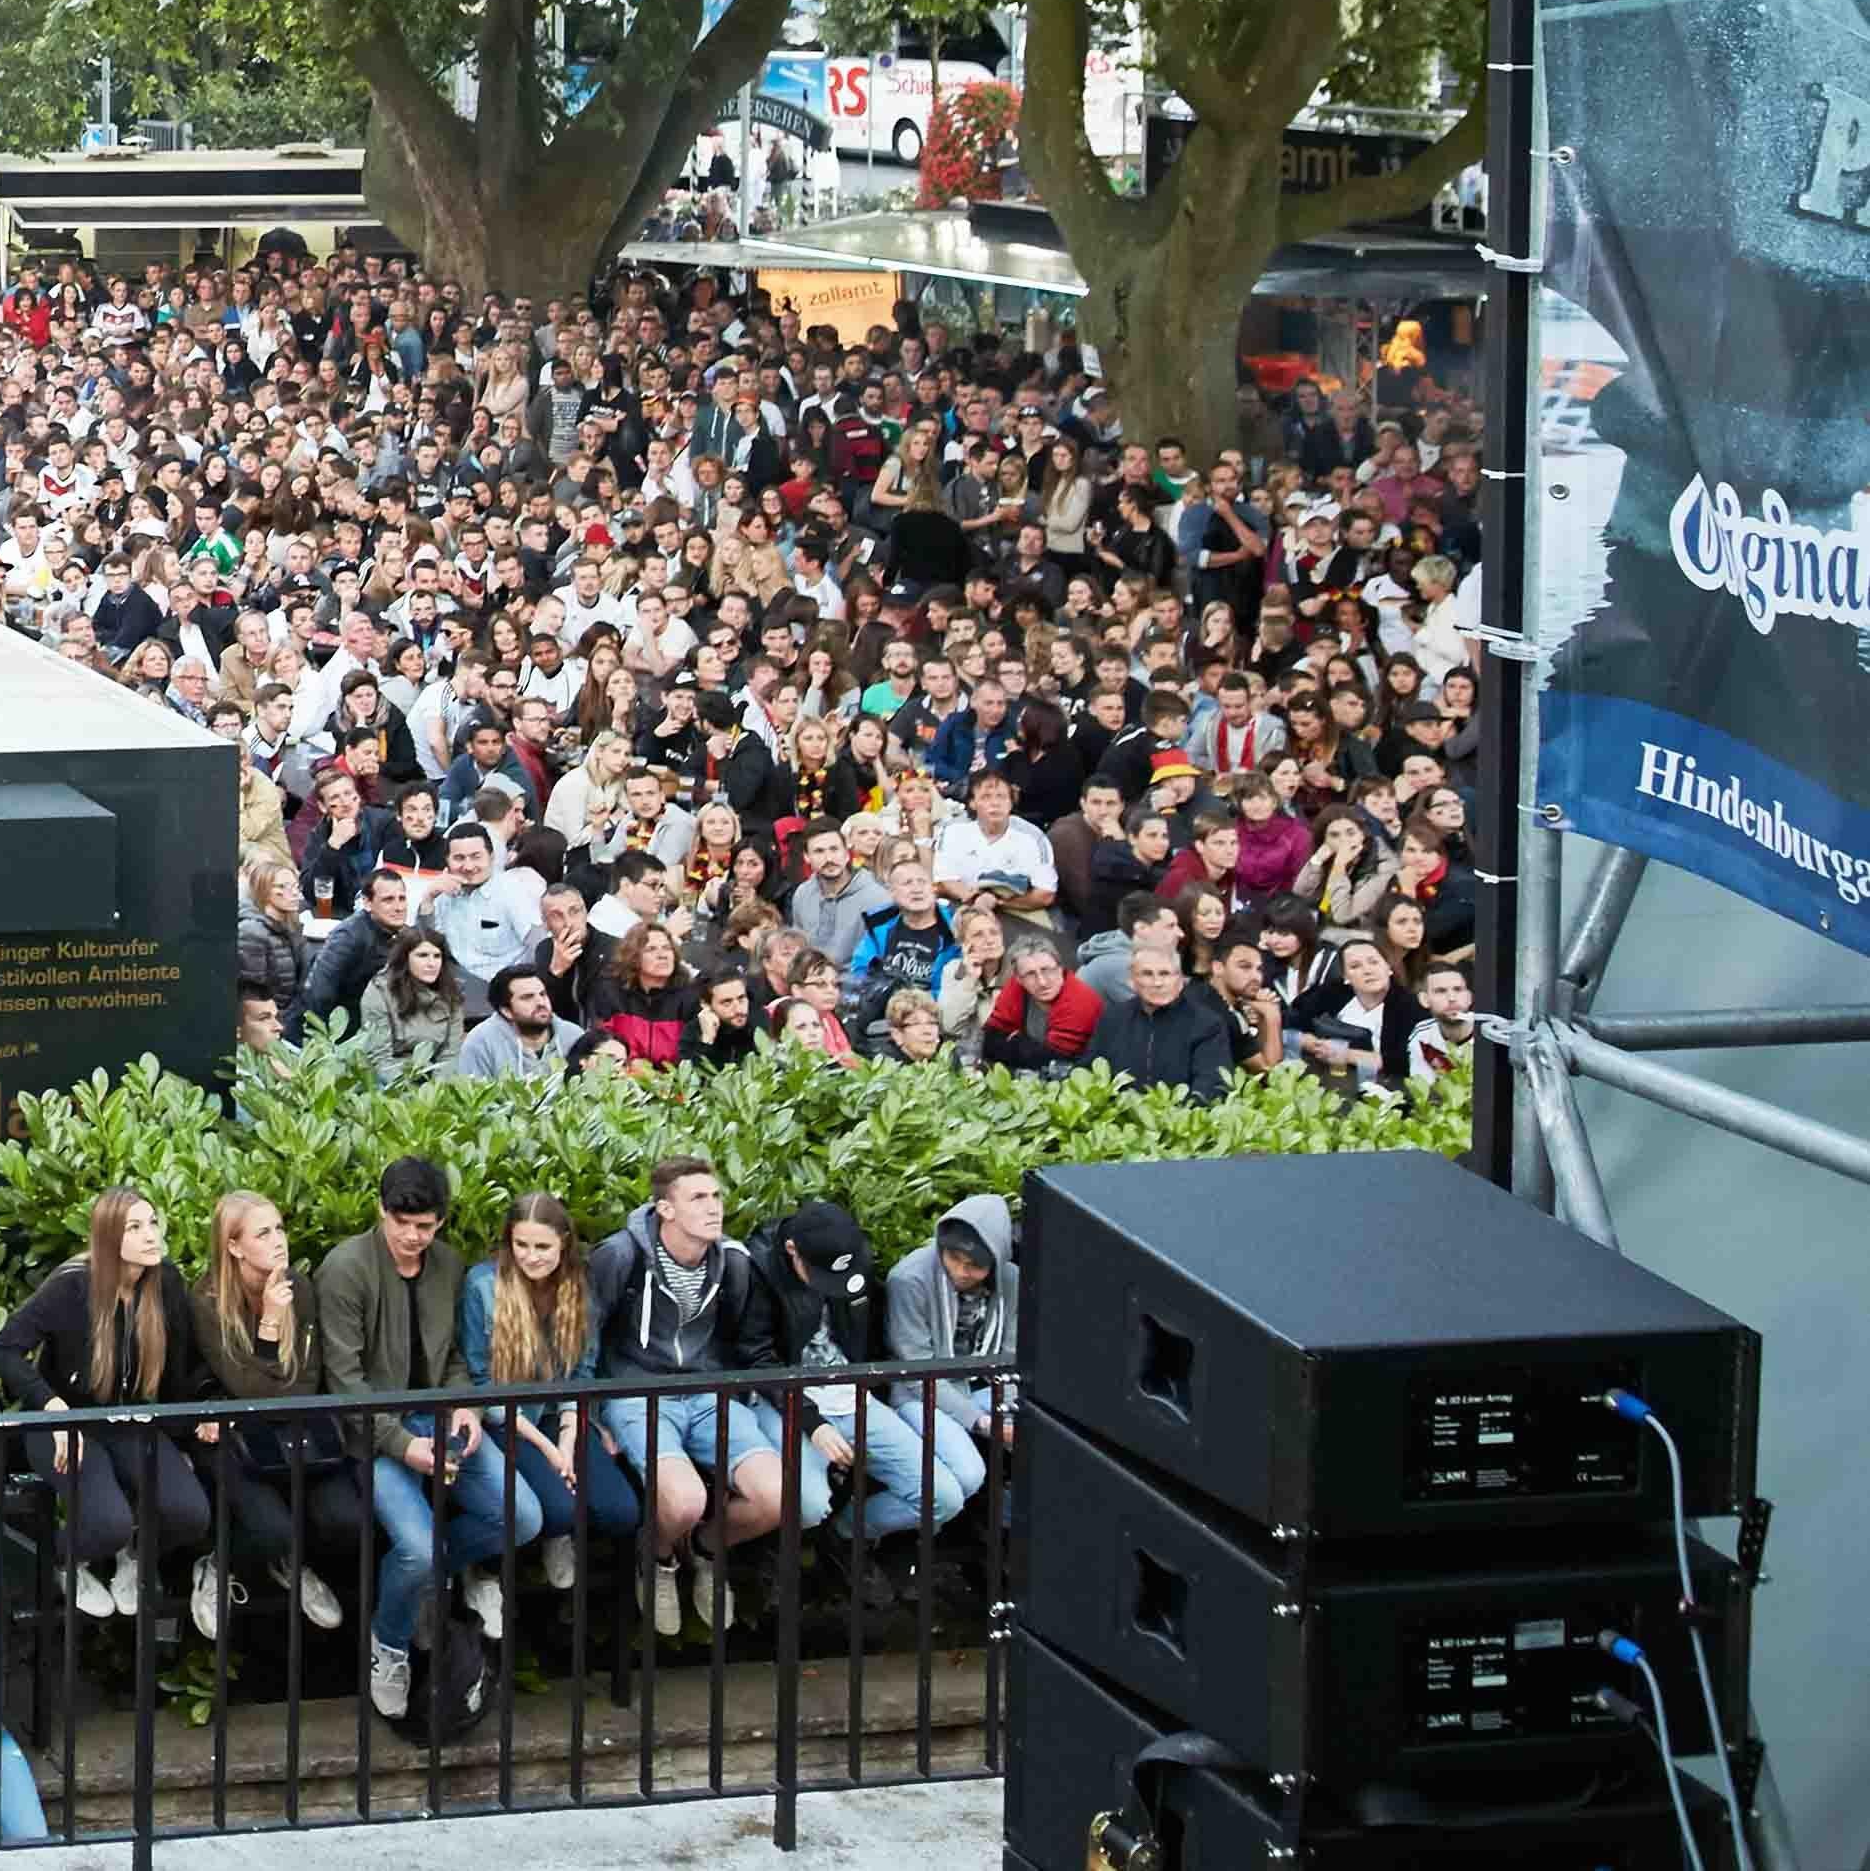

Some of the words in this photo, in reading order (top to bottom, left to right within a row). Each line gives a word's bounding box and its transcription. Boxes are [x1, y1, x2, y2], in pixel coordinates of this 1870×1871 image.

[810, 281, 884, 307] zollamt
[1679, 482, 1870, 624] Origina
[57, 939, 158, 960] Kulturufer
[88, 963, 180, 984] Ambiente
